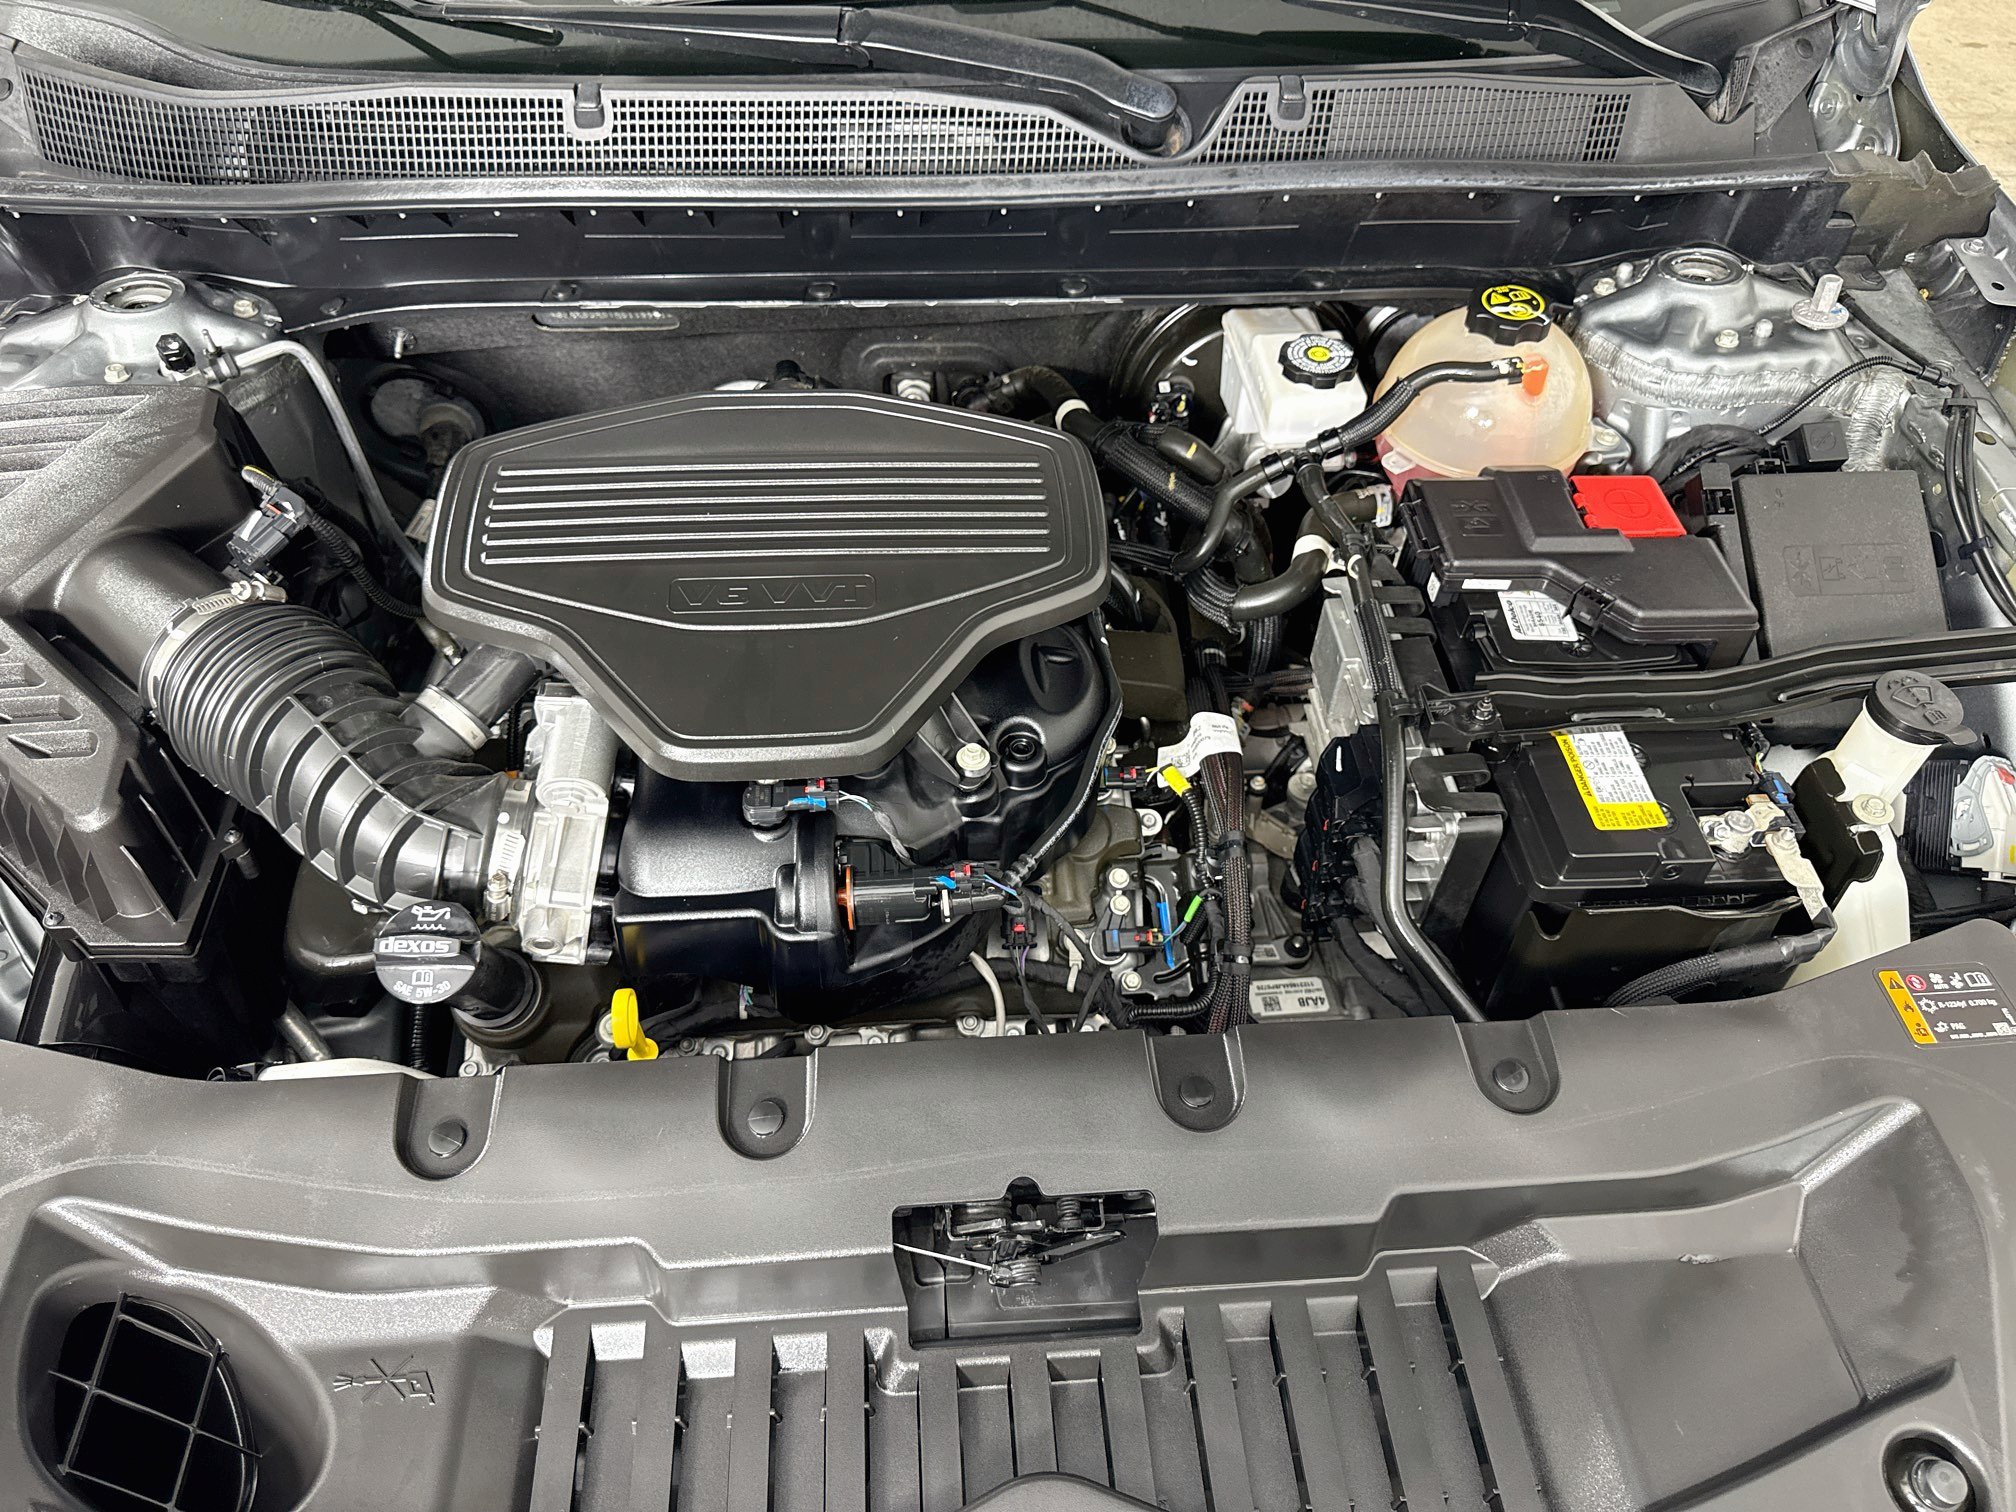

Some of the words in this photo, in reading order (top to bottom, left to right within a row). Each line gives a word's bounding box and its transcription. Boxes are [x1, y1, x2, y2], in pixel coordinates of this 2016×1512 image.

[677, 583, 749, 606] V6
[761, 581, 868, 605] VVT
[1506, 600, 1523, 634] ACDelco
[1562, 739, 1578, 764] POISON
[1573, 764, 1589, 793] DANGER
[379, 936, 453, 953] dexos
[393, 980, 414, 997] SAE
[415, 980, 452, 998] 5W-30
[1298, 997, 1325, 1007] 4AJB
